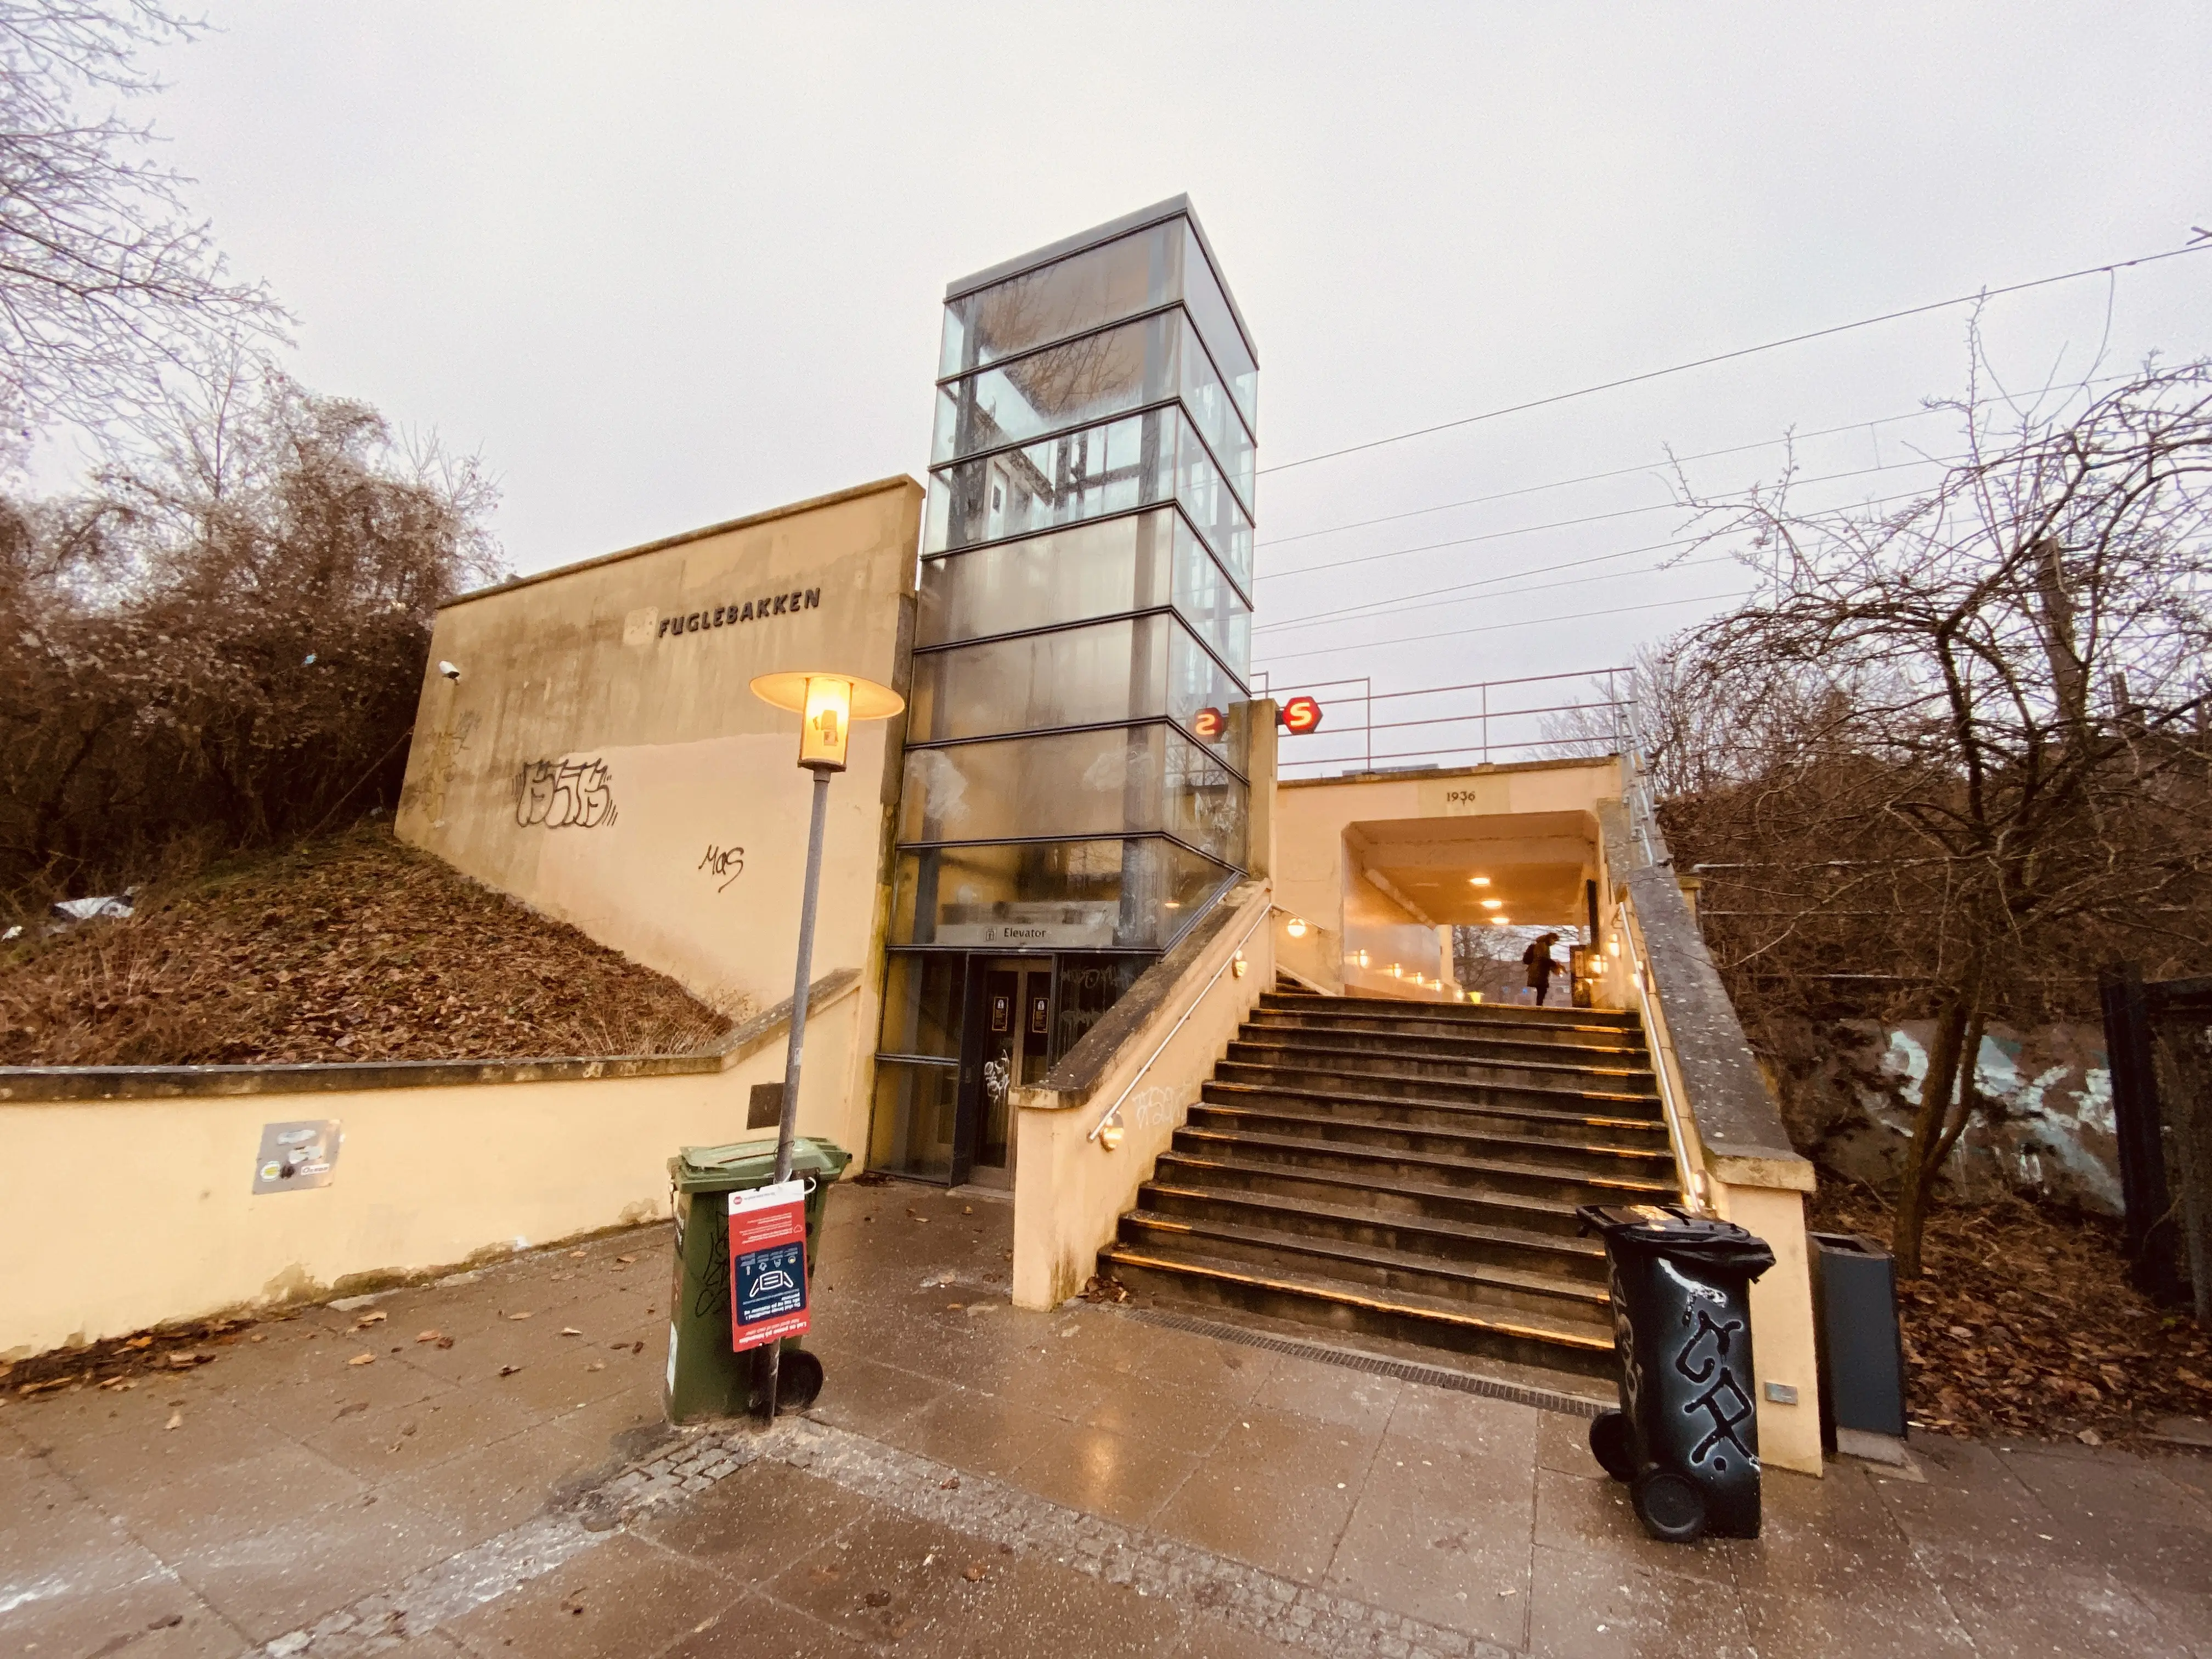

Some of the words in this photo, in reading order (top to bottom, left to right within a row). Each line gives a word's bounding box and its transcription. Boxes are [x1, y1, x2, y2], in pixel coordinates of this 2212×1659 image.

[658, 588, 821, 638] FUGLEBAKKEN
[1290, 702, 1312, 726] S
[1446, 791, 1476, 803] 1936
[1004, 928, 1047, 938] Elevator
